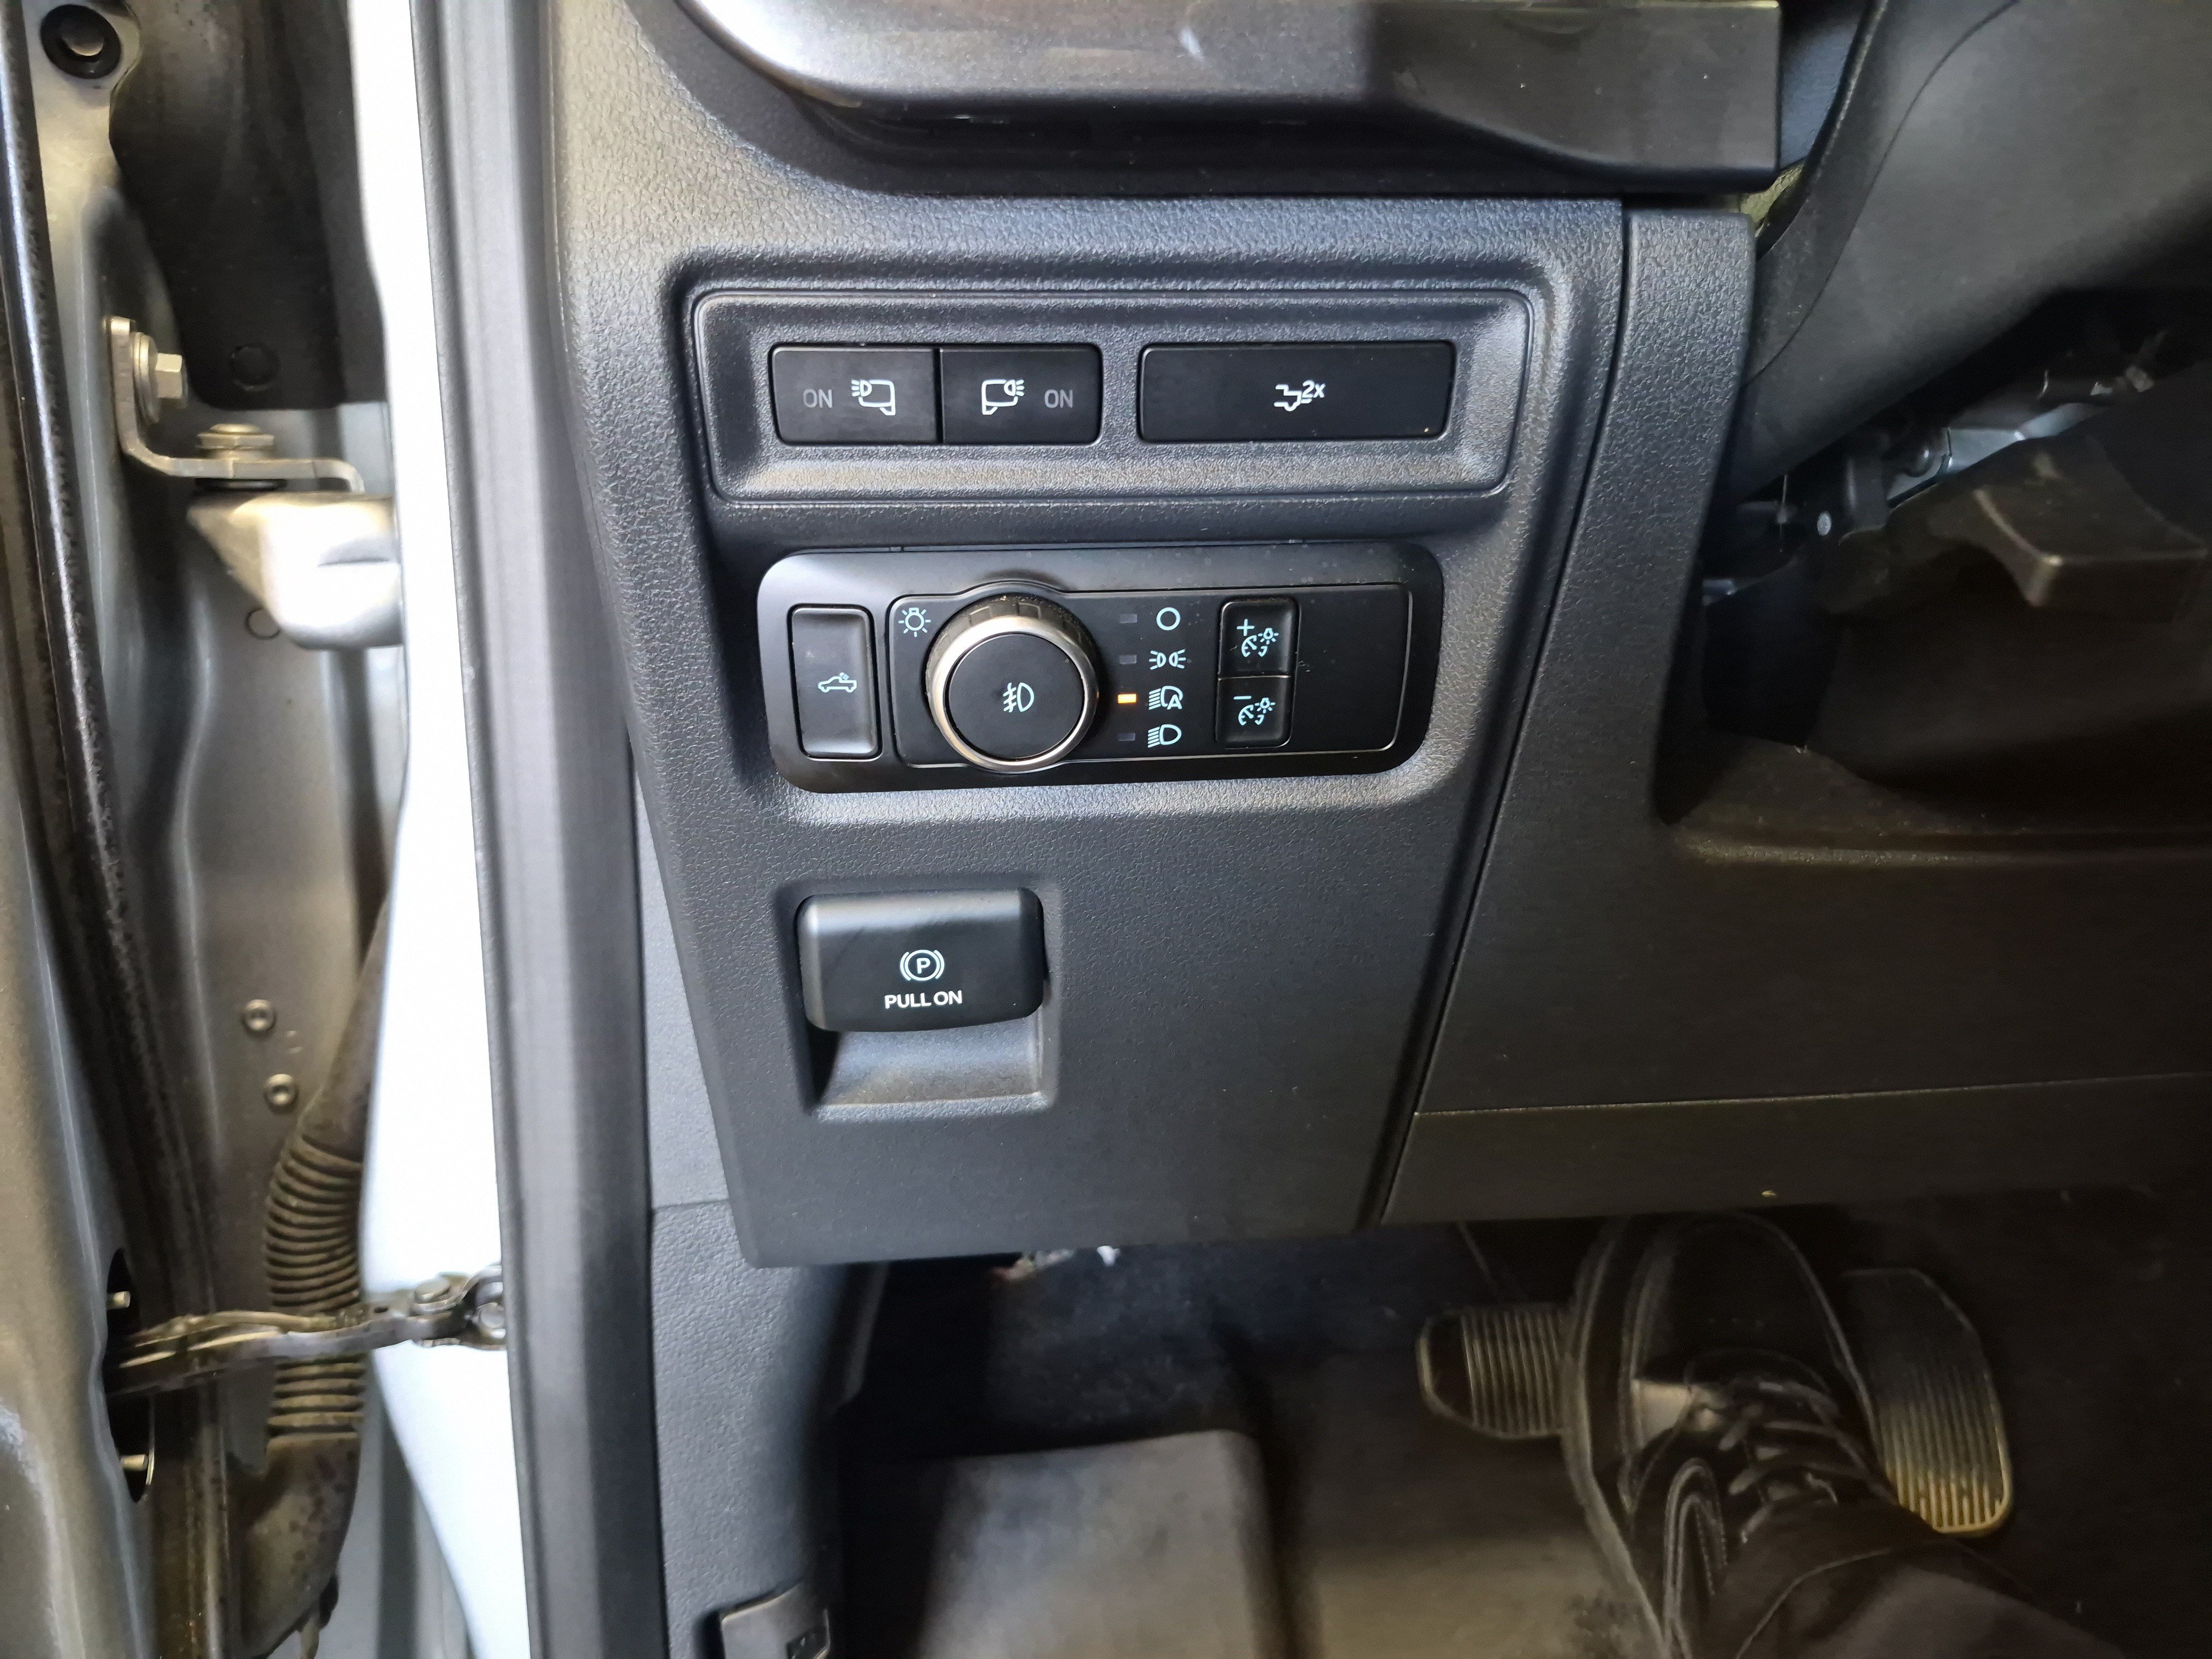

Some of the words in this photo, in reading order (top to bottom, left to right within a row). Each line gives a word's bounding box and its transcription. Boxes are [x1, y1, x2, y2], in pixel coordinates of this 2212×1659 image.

[803, 388, 833, 409] ON
[1302, 380, 1326, 398] 2x
[1044, 389, 1073, 409] ON
[916, 957, 931, 974] P
[884, 993, 932, 1009] PULL
[933, 990, 963, 1006] ON
